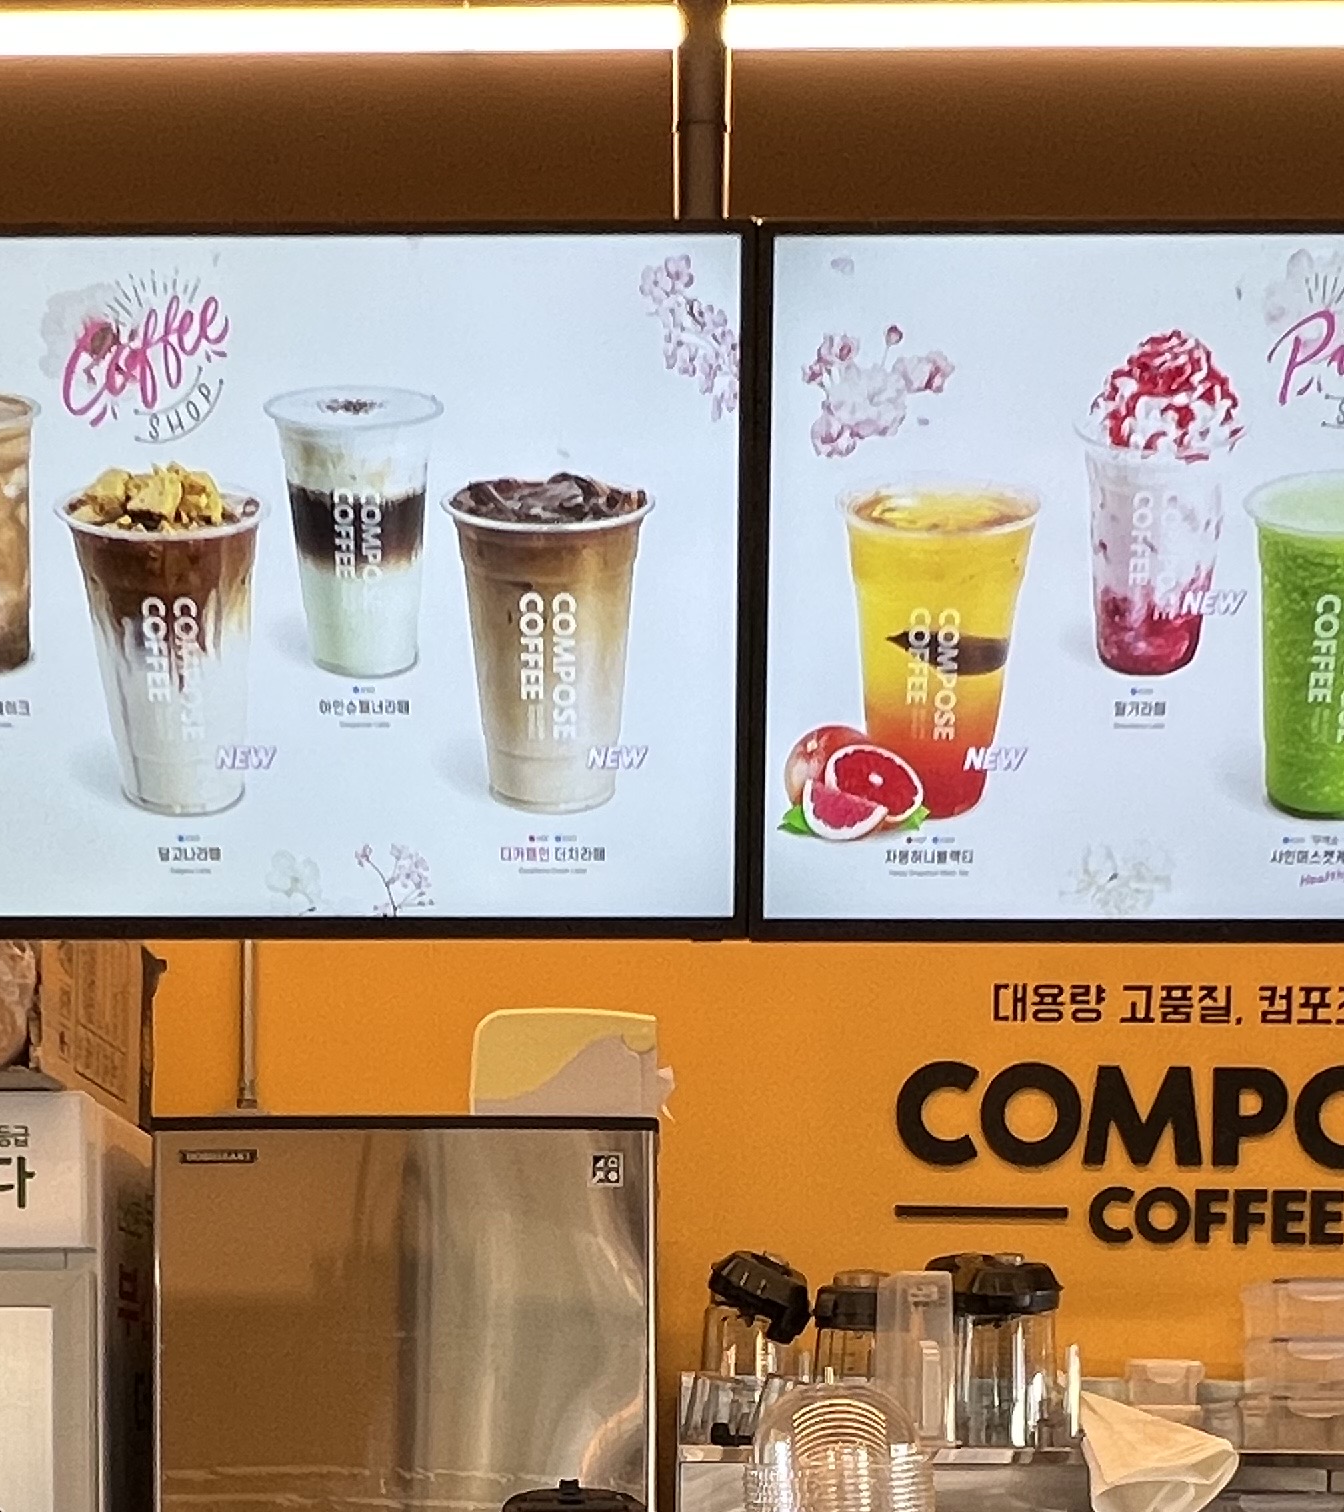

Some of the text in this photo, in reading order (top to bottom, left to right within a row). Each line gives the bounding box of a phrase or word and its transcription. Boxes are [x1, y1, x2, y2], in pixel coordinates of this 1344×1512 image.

[62, 295, 229, 417] Coffee
[147, 380, 214, 440] SHOP
[333, 488, 356, 580] COFFEE
[1129, 495, 1155, 587] COFFEE
[519, 591, 545, 701] COFFEE
[1182, 589, 1247, 617] NEW
[1308, 594, 1342, 704] COFFEE
[141, 596, 172, 704] COFFEE
[552, 592, 577, 742] COMPOSE
[906, 608, 931, 706] COFFEE
[933, 608, 961, 741] COMPOSE
[214, 745, 278, 771] NEW
[586, 745, 649, 771] NEW
[963, 746, 1028, 772] NEW
[992, 983, 1106, 1025] 대용량
[1120, 984, 1243, 1027] 고품질,
